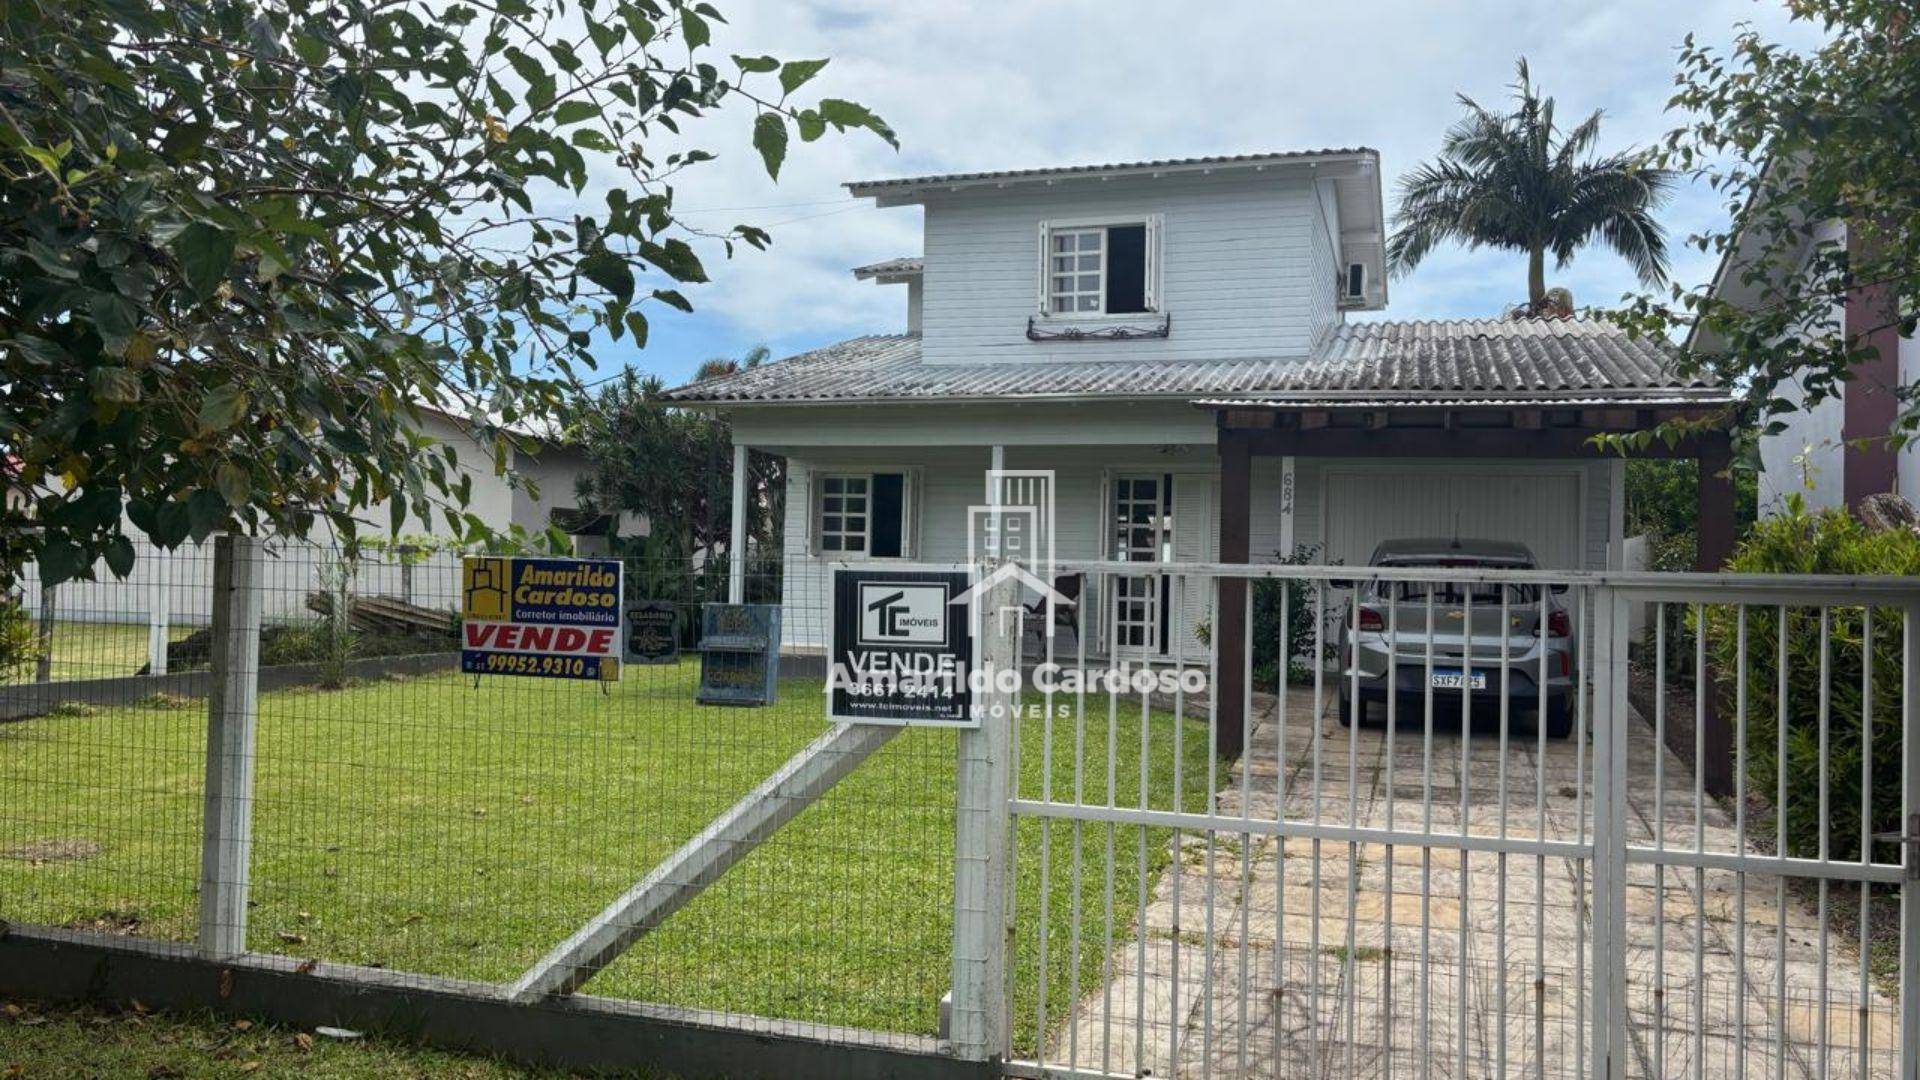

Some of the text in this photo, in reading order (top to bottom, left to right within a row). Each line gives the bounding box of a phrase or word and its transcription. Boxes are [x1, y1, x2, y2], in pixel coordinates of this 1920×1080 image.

[1282, 472, 1293, 515] 684
[521, 563, 616, 588] Amarildo
[515, 585, 616, 607] Cardoso
[515, 608, 556, 621] Corretor
[558, 609, 615, 623] imobiliário
[868, 590, 910, 637] TC
[899, 616, 939, 628] IMÓVEIS
[465, 623, 615, 654] VENDE
[486, 655, 585, 676] 99952.9310
[847, 650, 956, 677] VENDE
[903, 683, 954, 699] 2414
[849, 701, 954, 713] www.tcimoveis.net
